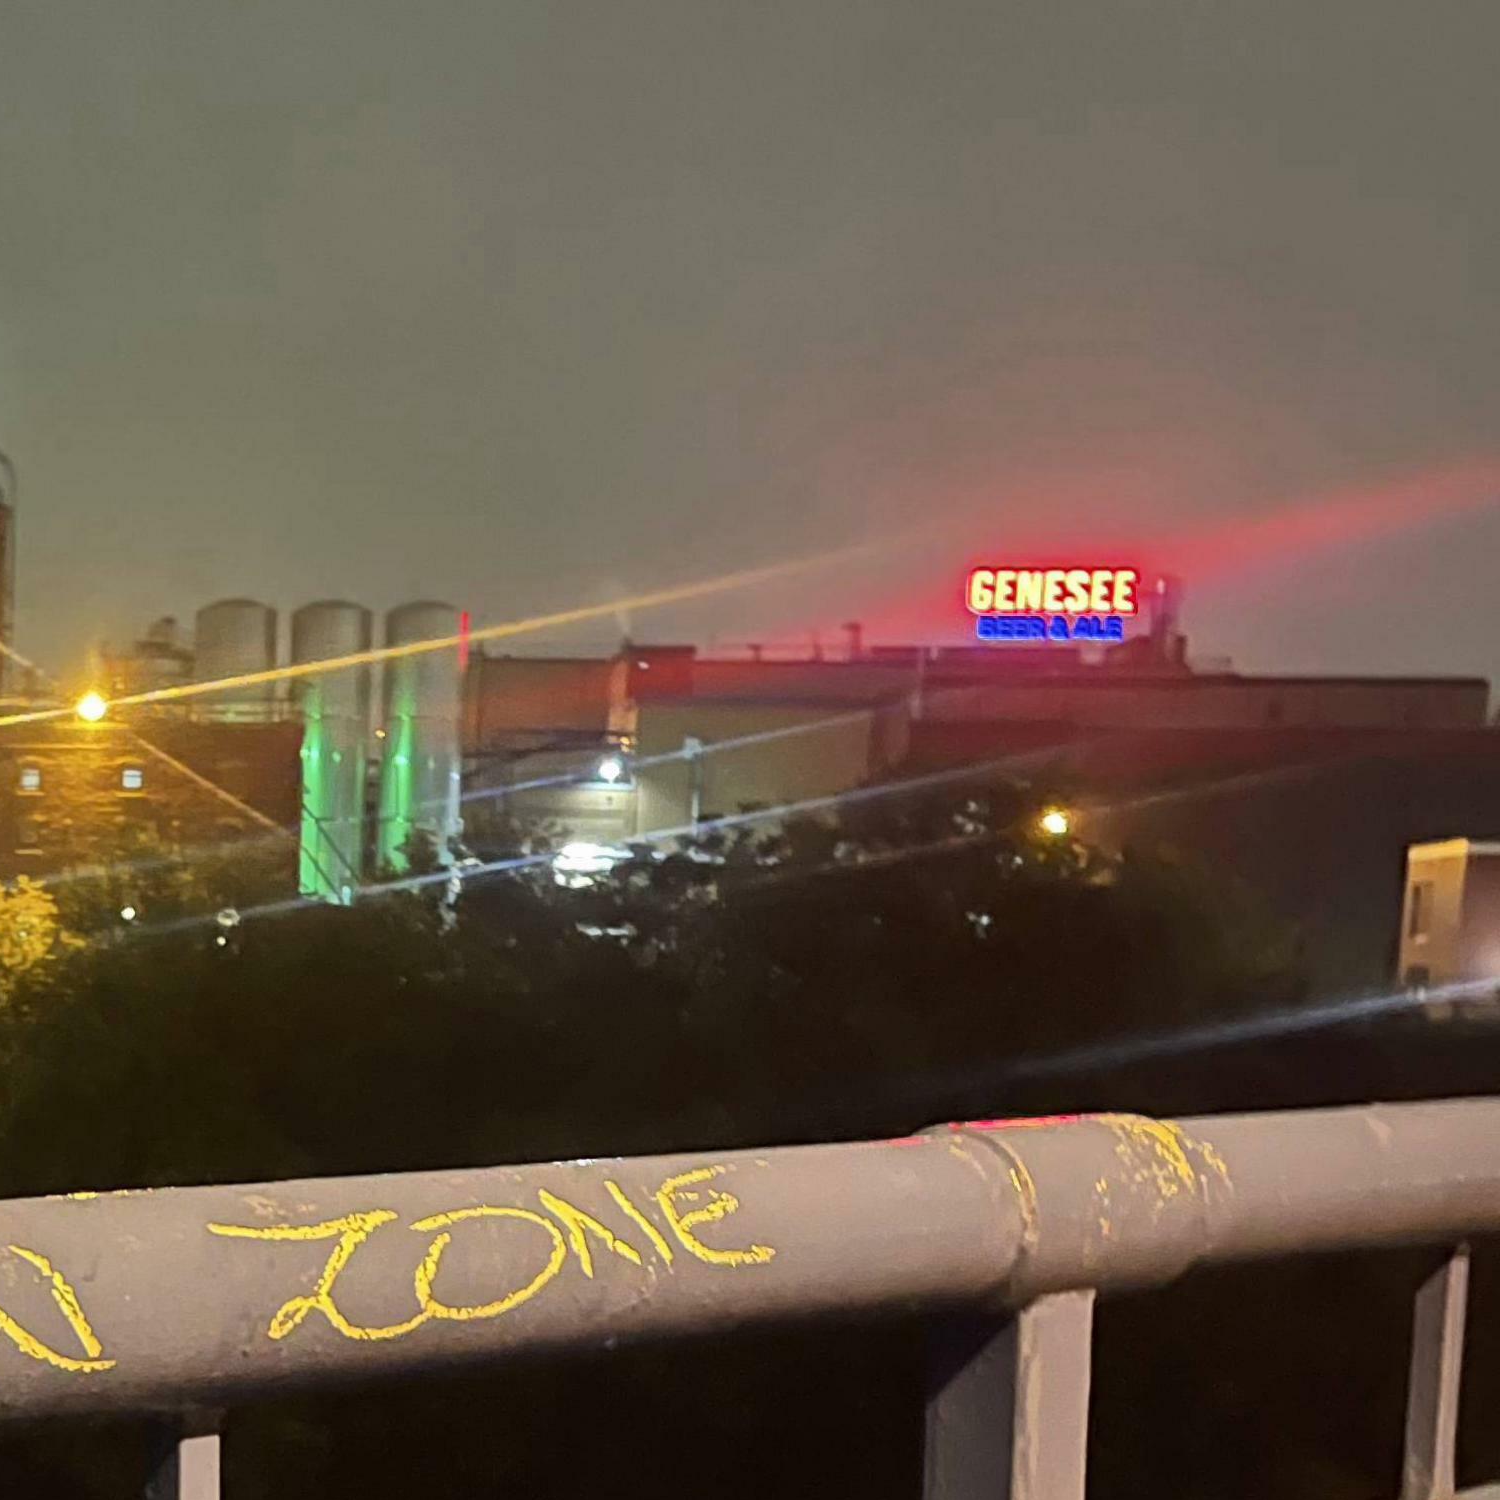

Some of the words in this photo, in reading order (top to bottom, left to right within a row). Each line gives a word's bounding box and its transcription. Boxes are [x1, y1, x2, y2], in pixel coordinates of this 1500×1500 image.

[969, 569, 1138, 613] GENESEE
[977, 615, 1047, 640] BEER
[1072, 615, 1123, 640] ALE
[206, 1166, 776, 1341] ZONE
